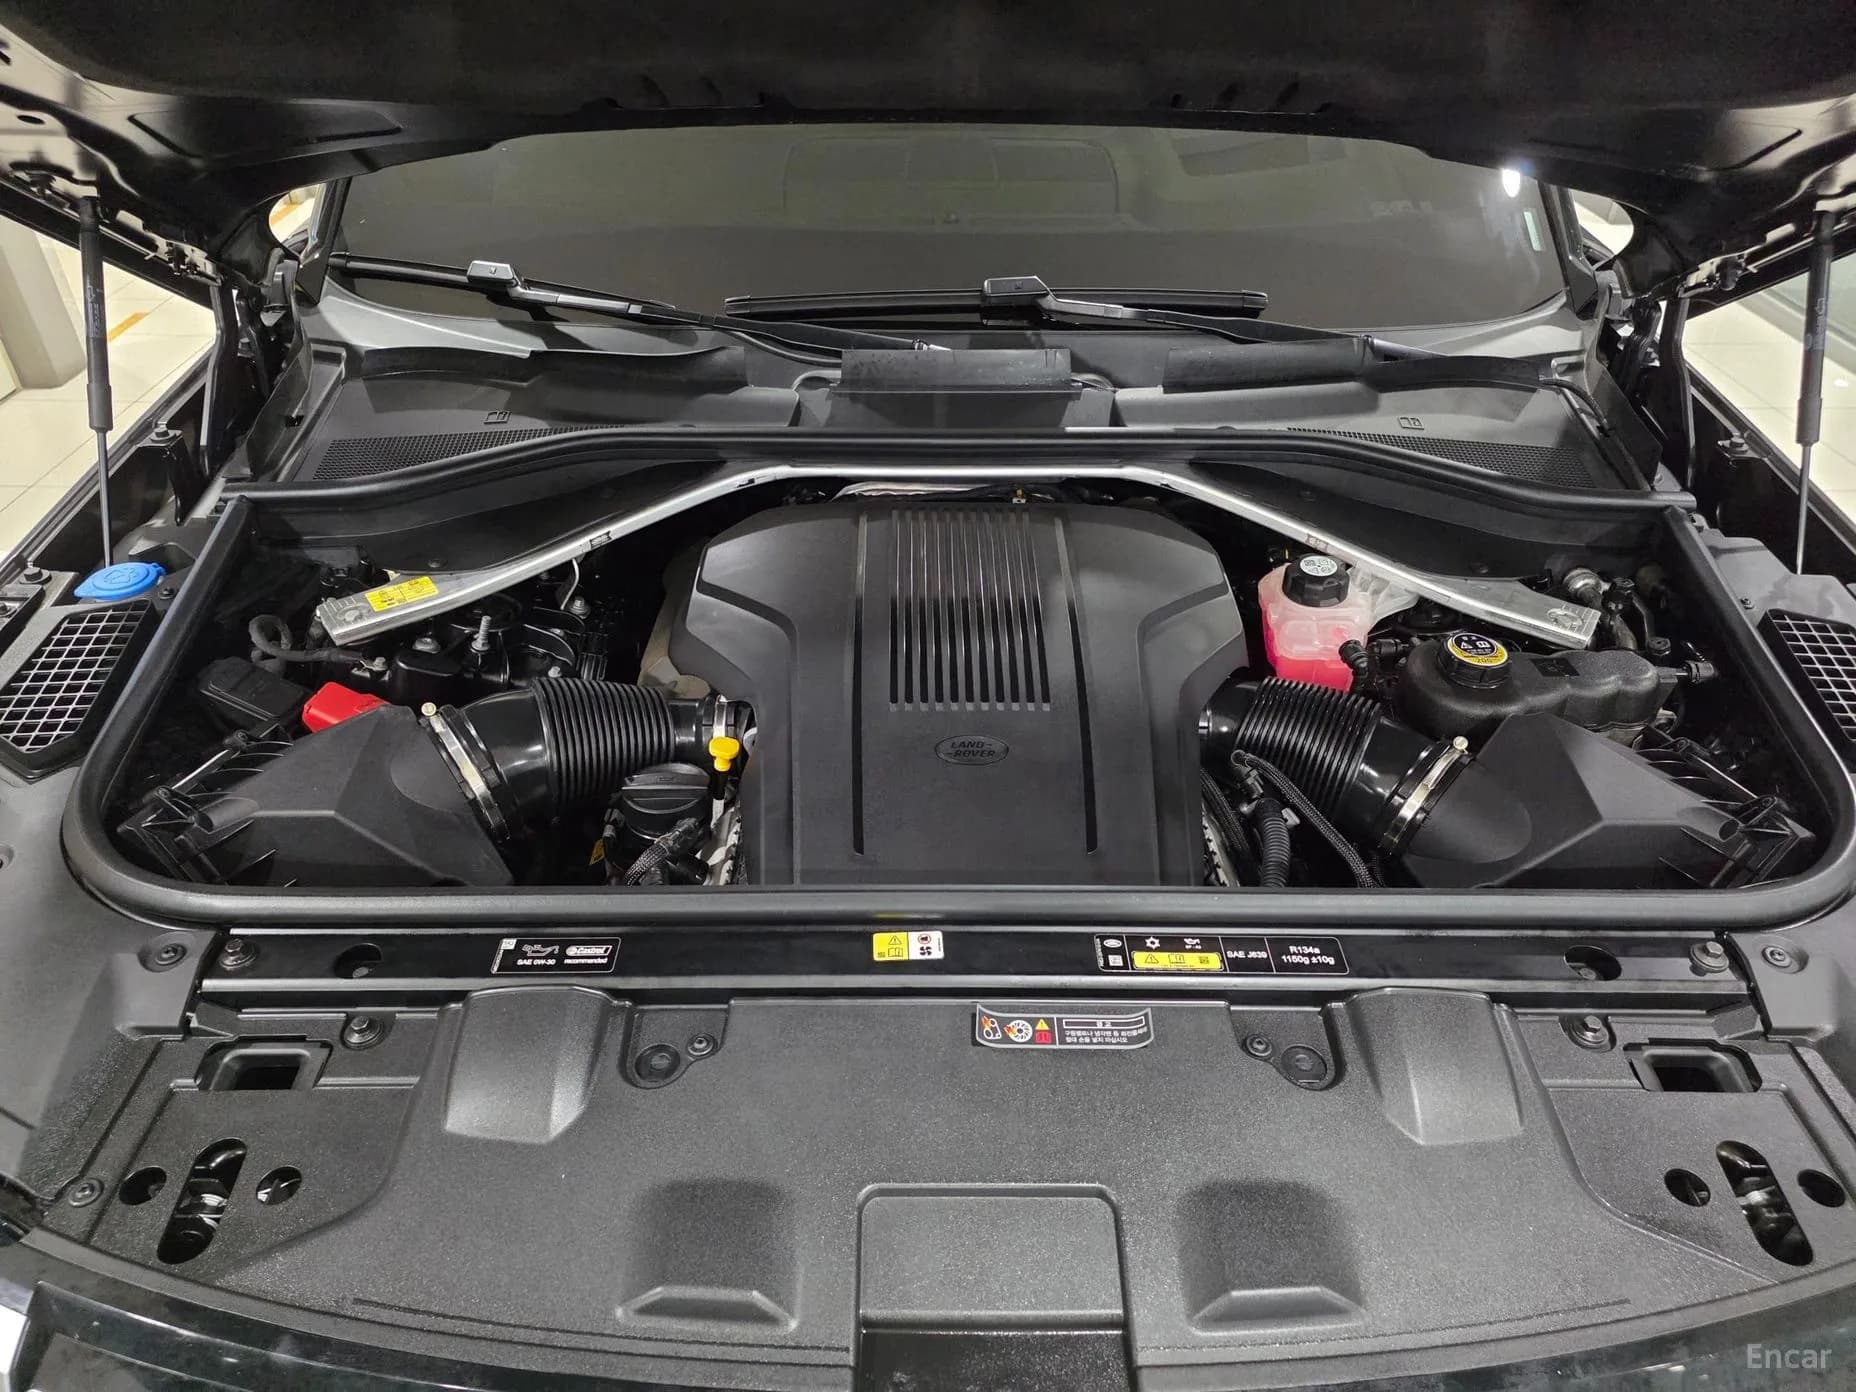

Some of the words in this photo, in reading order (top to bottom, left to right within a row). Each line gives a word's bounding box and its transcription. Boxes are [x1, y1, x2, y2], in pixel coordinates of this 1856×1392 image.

[951, 741, 985, 749] LAND
[953, 750, 996, 758] ROVER
[1289, 946, 1320, 954] R134a
[1226, 950, 1246, 959] SAE
[1311, 956, 1335, 966] ±10g
